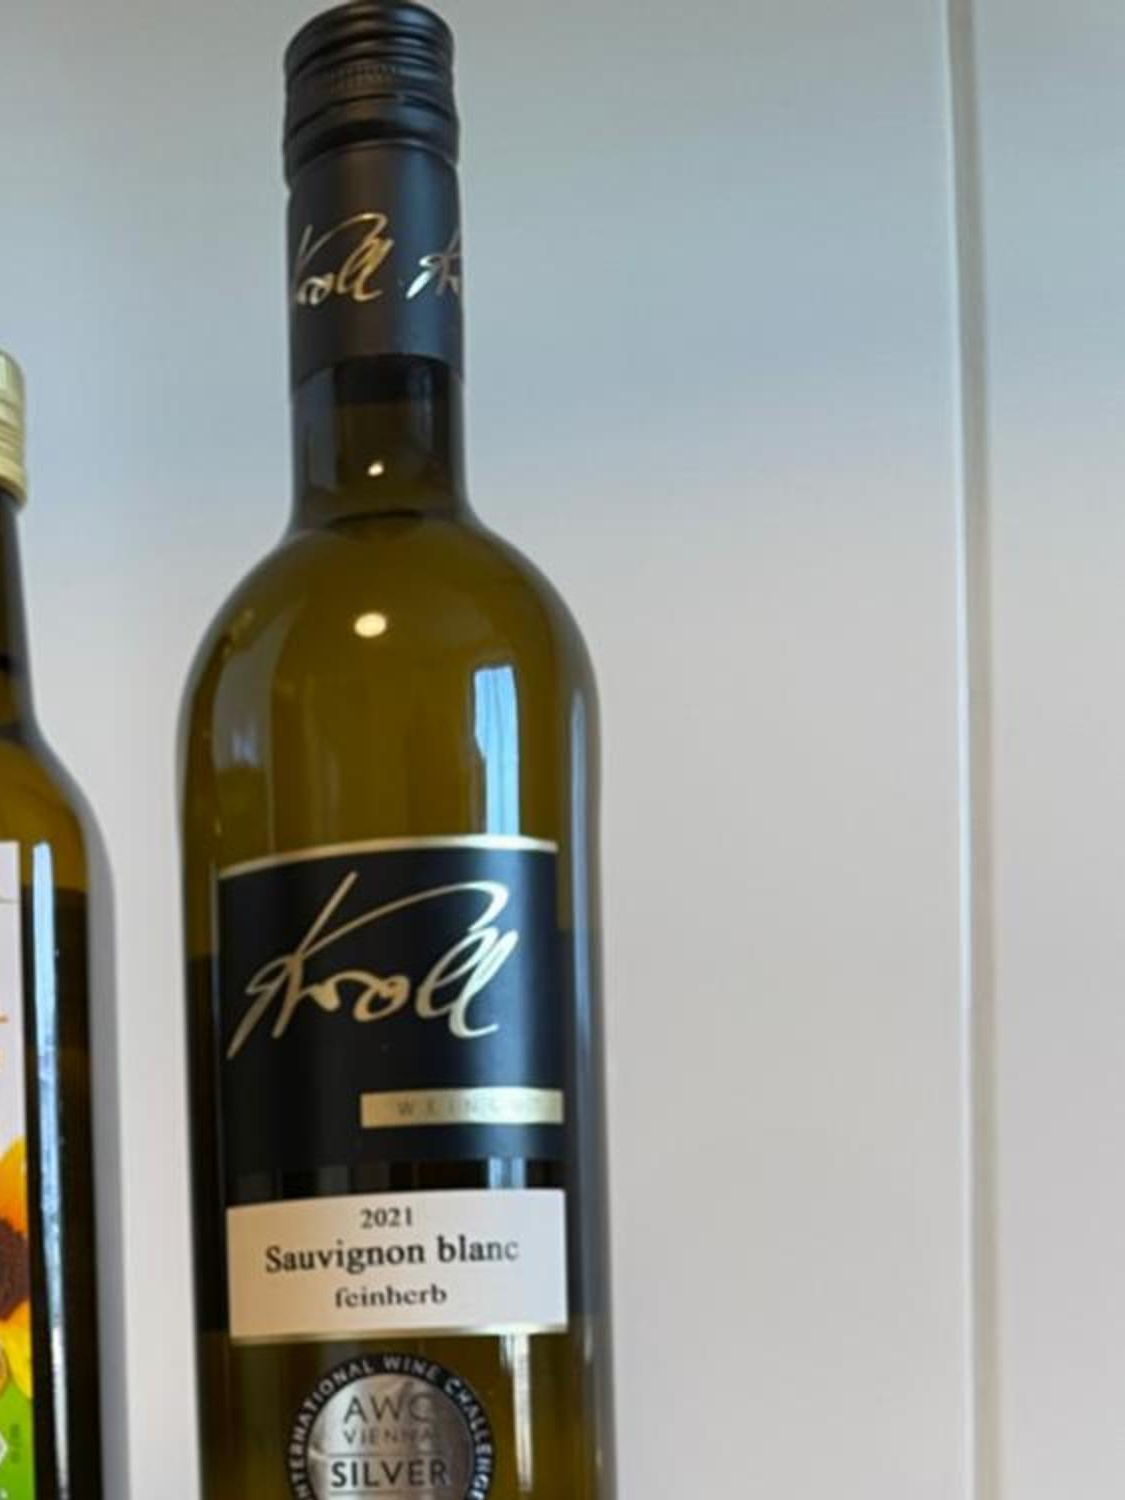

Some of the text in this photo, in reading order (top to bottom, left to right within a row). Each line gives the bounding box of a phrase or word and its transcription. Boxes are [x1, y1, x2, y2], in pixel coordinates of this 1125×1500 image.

[227, 869, 519, 1060] Kroll
[359, 1206, 414, 1230] 2021
[264, 1233, 521, 1274] Sauvignon blanc
[333, 1283, 448, 1309] feinherb
[382, 1354, 438, 1384] WINE
[330, 1459, 449, 1489] SILVER
